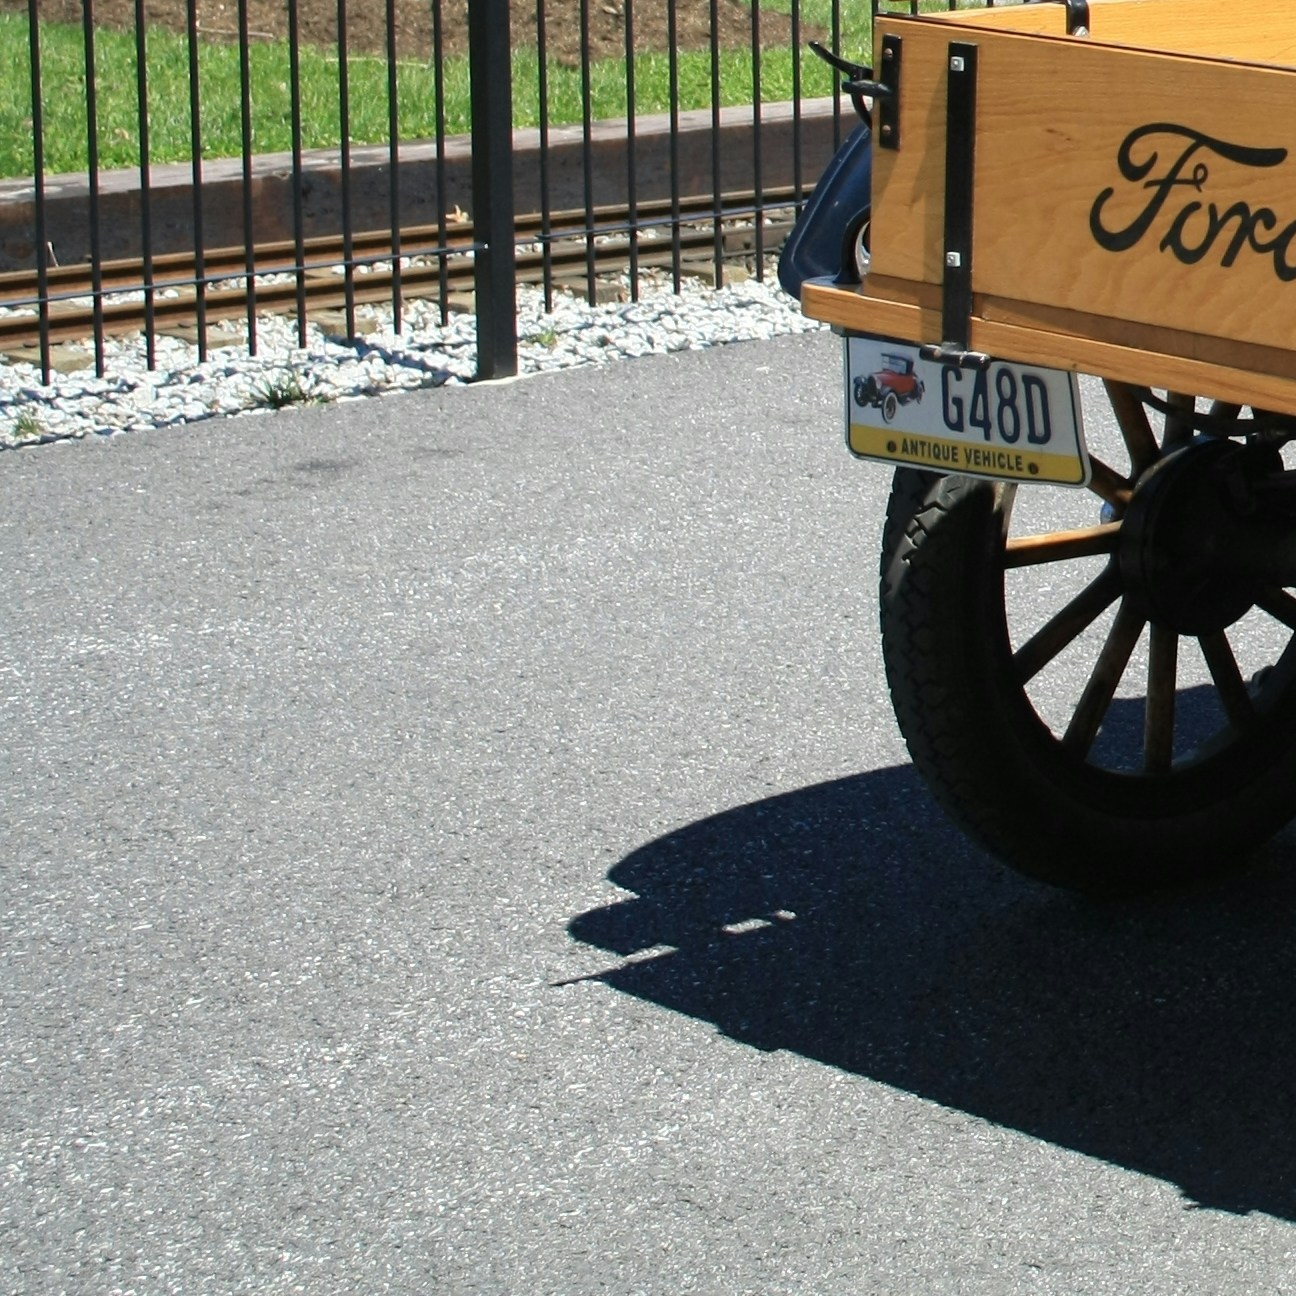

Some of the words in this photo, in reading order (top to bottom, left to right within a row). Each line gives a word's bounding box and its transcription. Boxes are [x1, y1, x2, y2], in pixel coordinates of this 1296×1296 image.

[941, 364, 1053, 446] G48D
[901, 438, 959, 464] ANTIQUE
[964, 447, 1024, 473] VEHICLE
